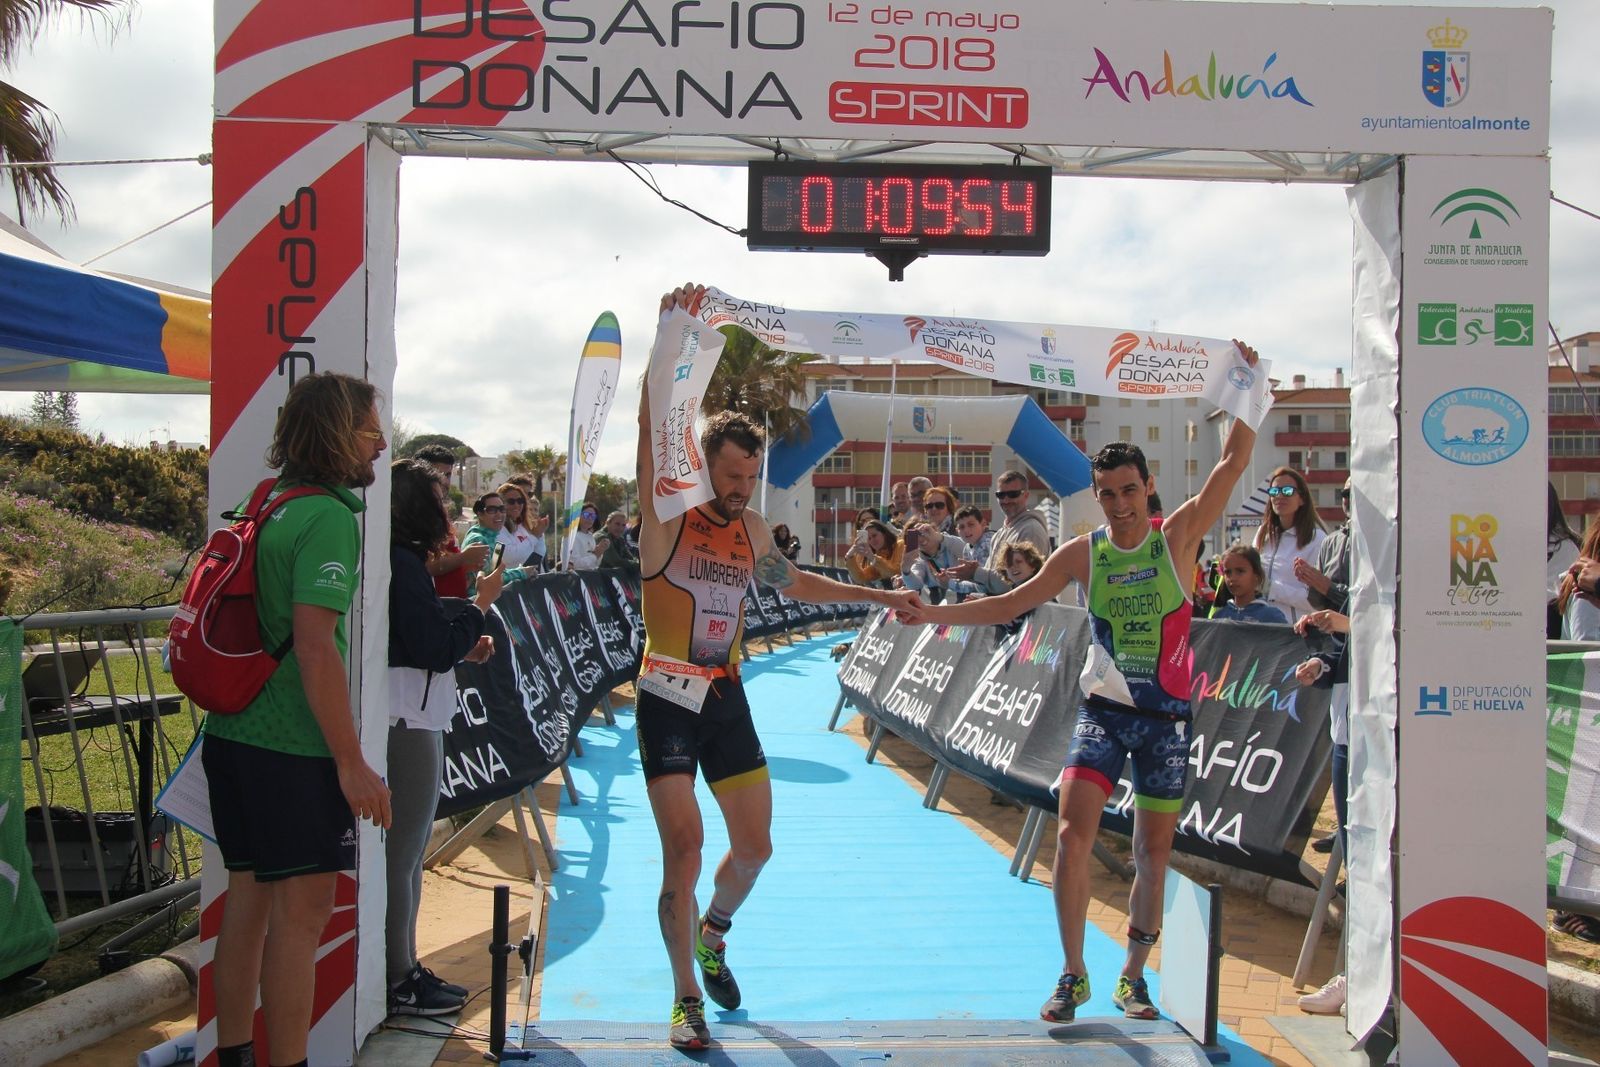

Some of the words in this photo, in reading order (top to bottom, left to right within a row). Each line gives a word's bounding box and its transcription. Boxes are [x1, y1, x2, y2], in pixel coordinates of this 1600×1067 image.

[828, 3, 858, 23] 12
[871, 5, 913, 25] de
[925, 10, 1020, 32] mayo
[855, 34, 996, 71] 2018
[412, 55, 803, 120] DOÑANA
[1082, 47, 1315, 107] Andalucía
[834, 88, 1025, 123] SPRINT
[1361, 115, 1531, 132] ayuntamientoalmonte
[1428, 244, 1456, 256] JUNTA
[1460, 245, 1472, 256] DE
[1145, 336, 1208, 357] Andalucía
[926, 348, 963, 364] SPRINT
[964, 359, 995, 373] 2018
[1120, 353, 1209, 369] DESAFÍO
[1119, 368, 1205, 383] DOÑANA
[1119, 383, 1165, 393] SPRINT
[1166, 383, 1203, 393] 2018
[1428, 395, 1458, 418] CLUB
[1443, 447, 1511, 462] ALMONTE
[688, 555, 749, 589] LUMBRERAS
[1109, 592, 1163, 618] CORDERO
[904, 655, 954, 693] DESAFÍO
[1453, 684, 1531, 697] DIPUTACIÓN
[886, 688, 933, 731] DOÑANA
[973, 681, 1043, 727] DESAFÍO
[1453, 700, 1469, 710] DE
[1473, 700, 1524, 710] HUELVA
[952, 721, 1017, 775] DOÑANA
